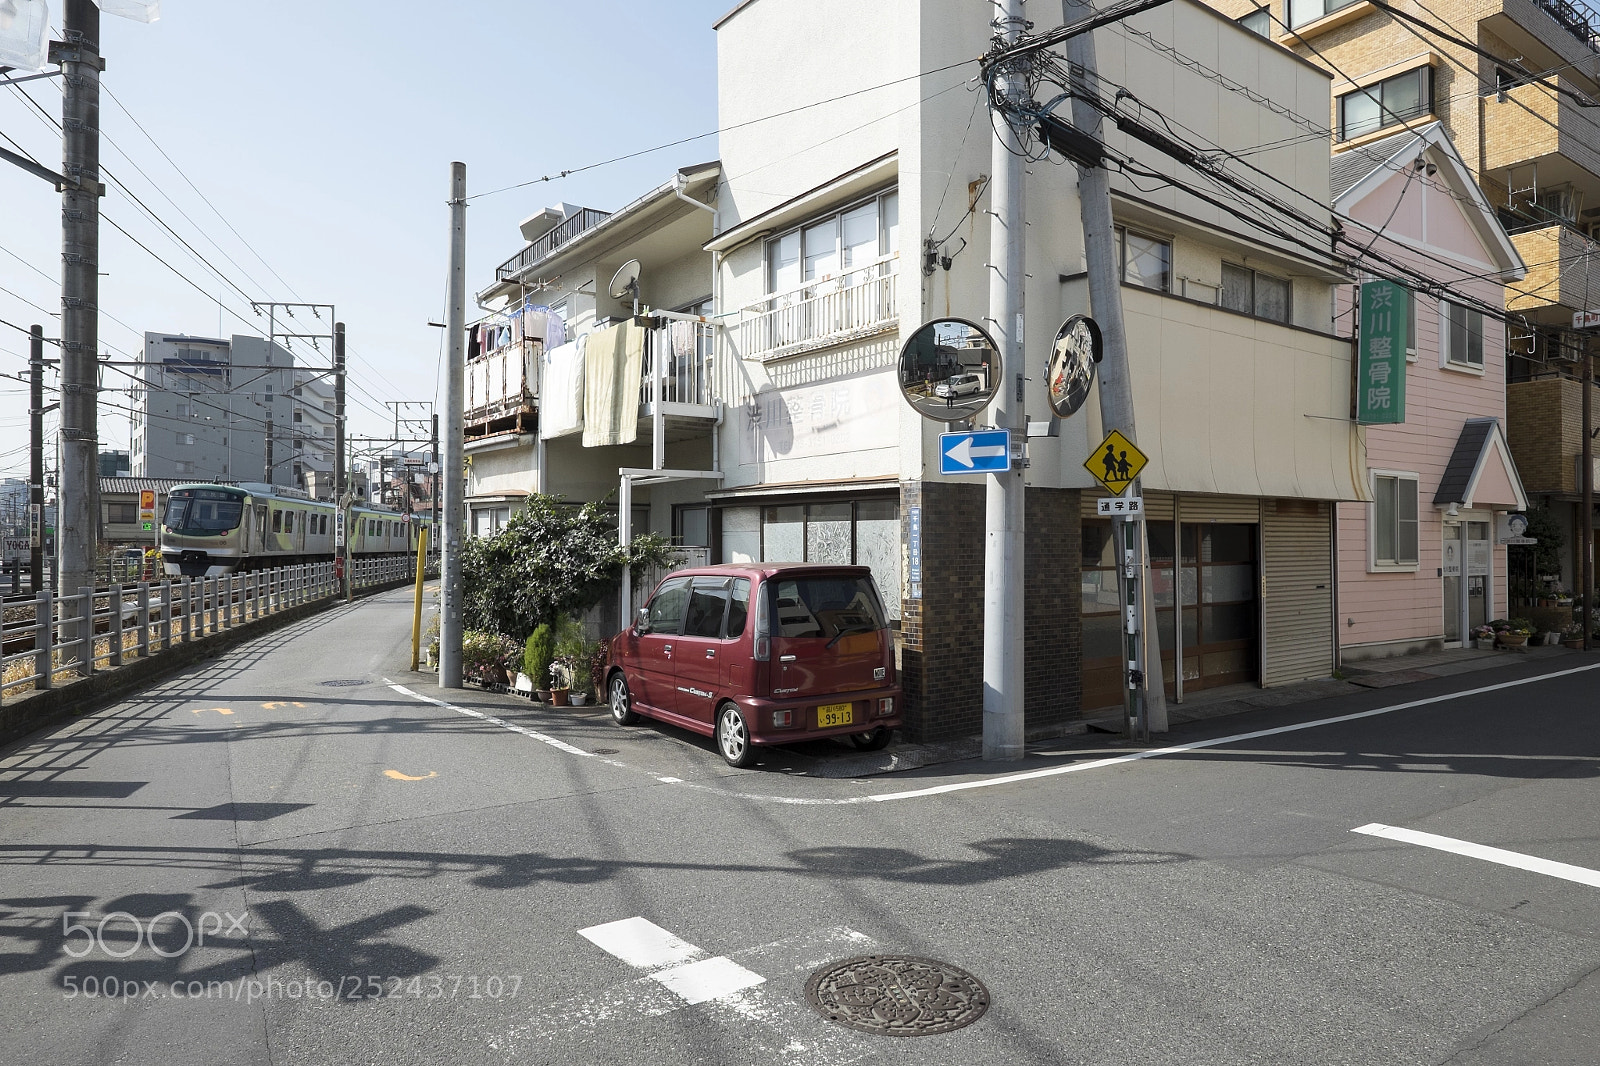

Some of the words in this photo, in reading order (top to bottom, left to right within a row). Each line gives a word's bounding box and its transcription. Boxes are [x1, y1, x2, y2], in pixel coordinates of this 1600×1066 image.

[1367, 285, 1393, 410] 渋川整骨院
[141, 491, 154, 508] P
[1100, 501, 1139, 512] 通学路
[911, 557, 919, 566] 18
